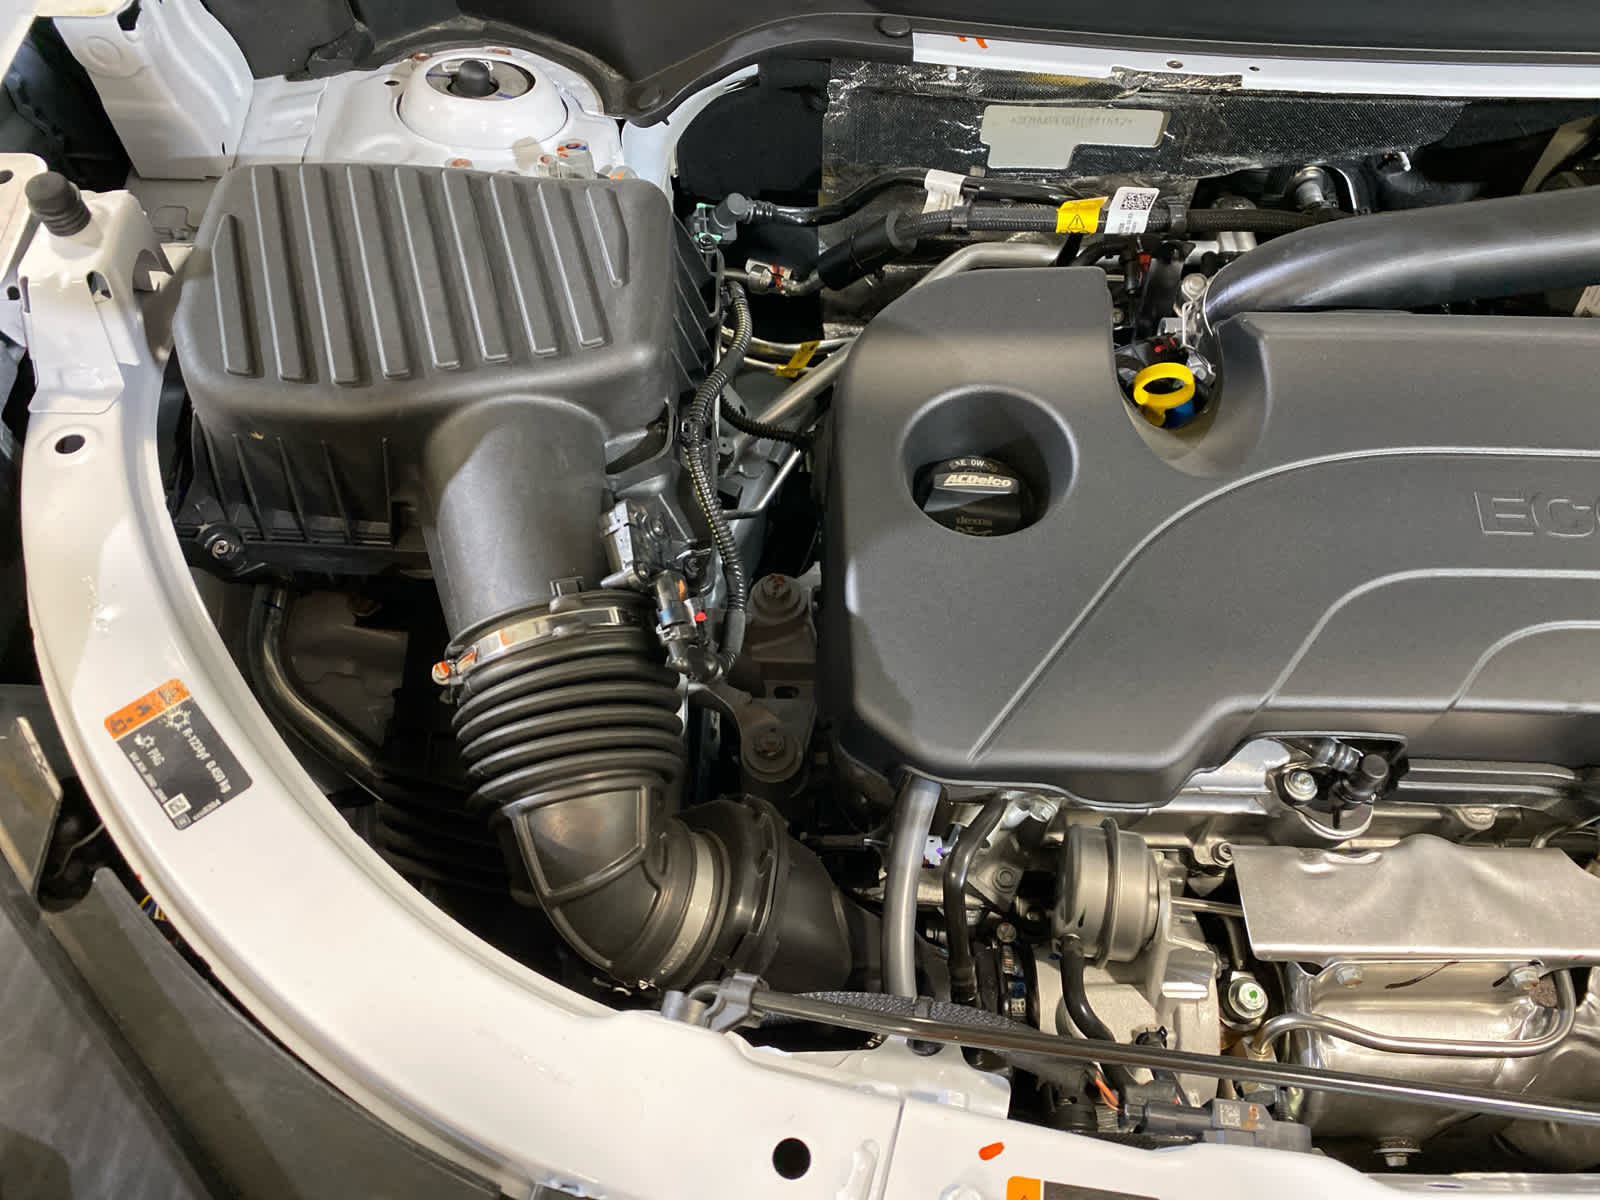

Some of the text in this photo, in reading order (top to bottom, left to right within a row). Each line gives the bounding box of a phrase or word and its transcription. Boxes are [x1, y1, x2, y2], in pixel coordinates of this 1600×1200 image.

[944, 474, 1012, 488] ACDelco
[1474, 489, 1600, 537] EC
[147, 747, 166, 767] PAG
